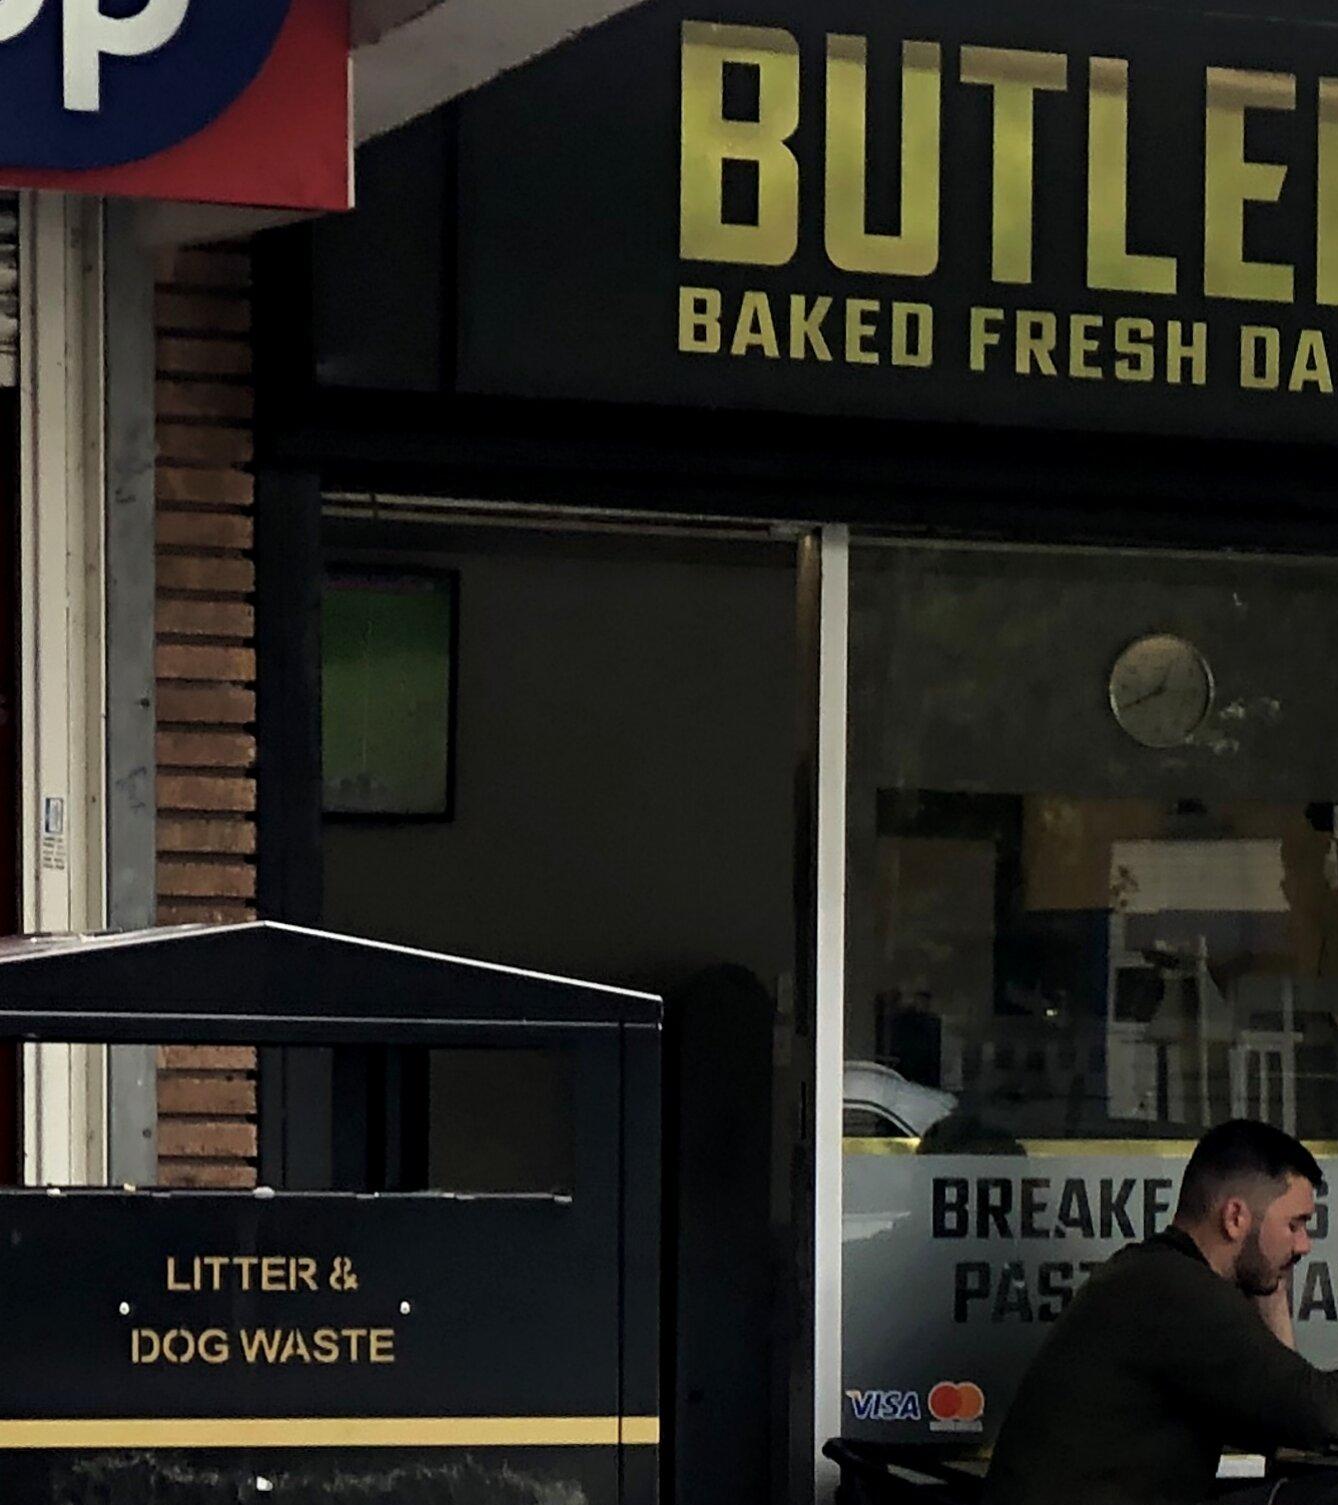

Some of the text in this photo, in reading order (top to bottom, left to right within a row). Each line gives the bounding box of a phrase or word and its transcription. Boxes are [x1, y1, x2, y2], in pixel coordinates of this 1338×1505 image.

[677, 286, 933, 369] BAKED
[969, 306, 1207, 387] FRESH
[166, 1256, 359, 1292] LITTER &
[131, 1328, 397, 1365] DOG WASTE
[845, 1389, 922, 1421] VISA
